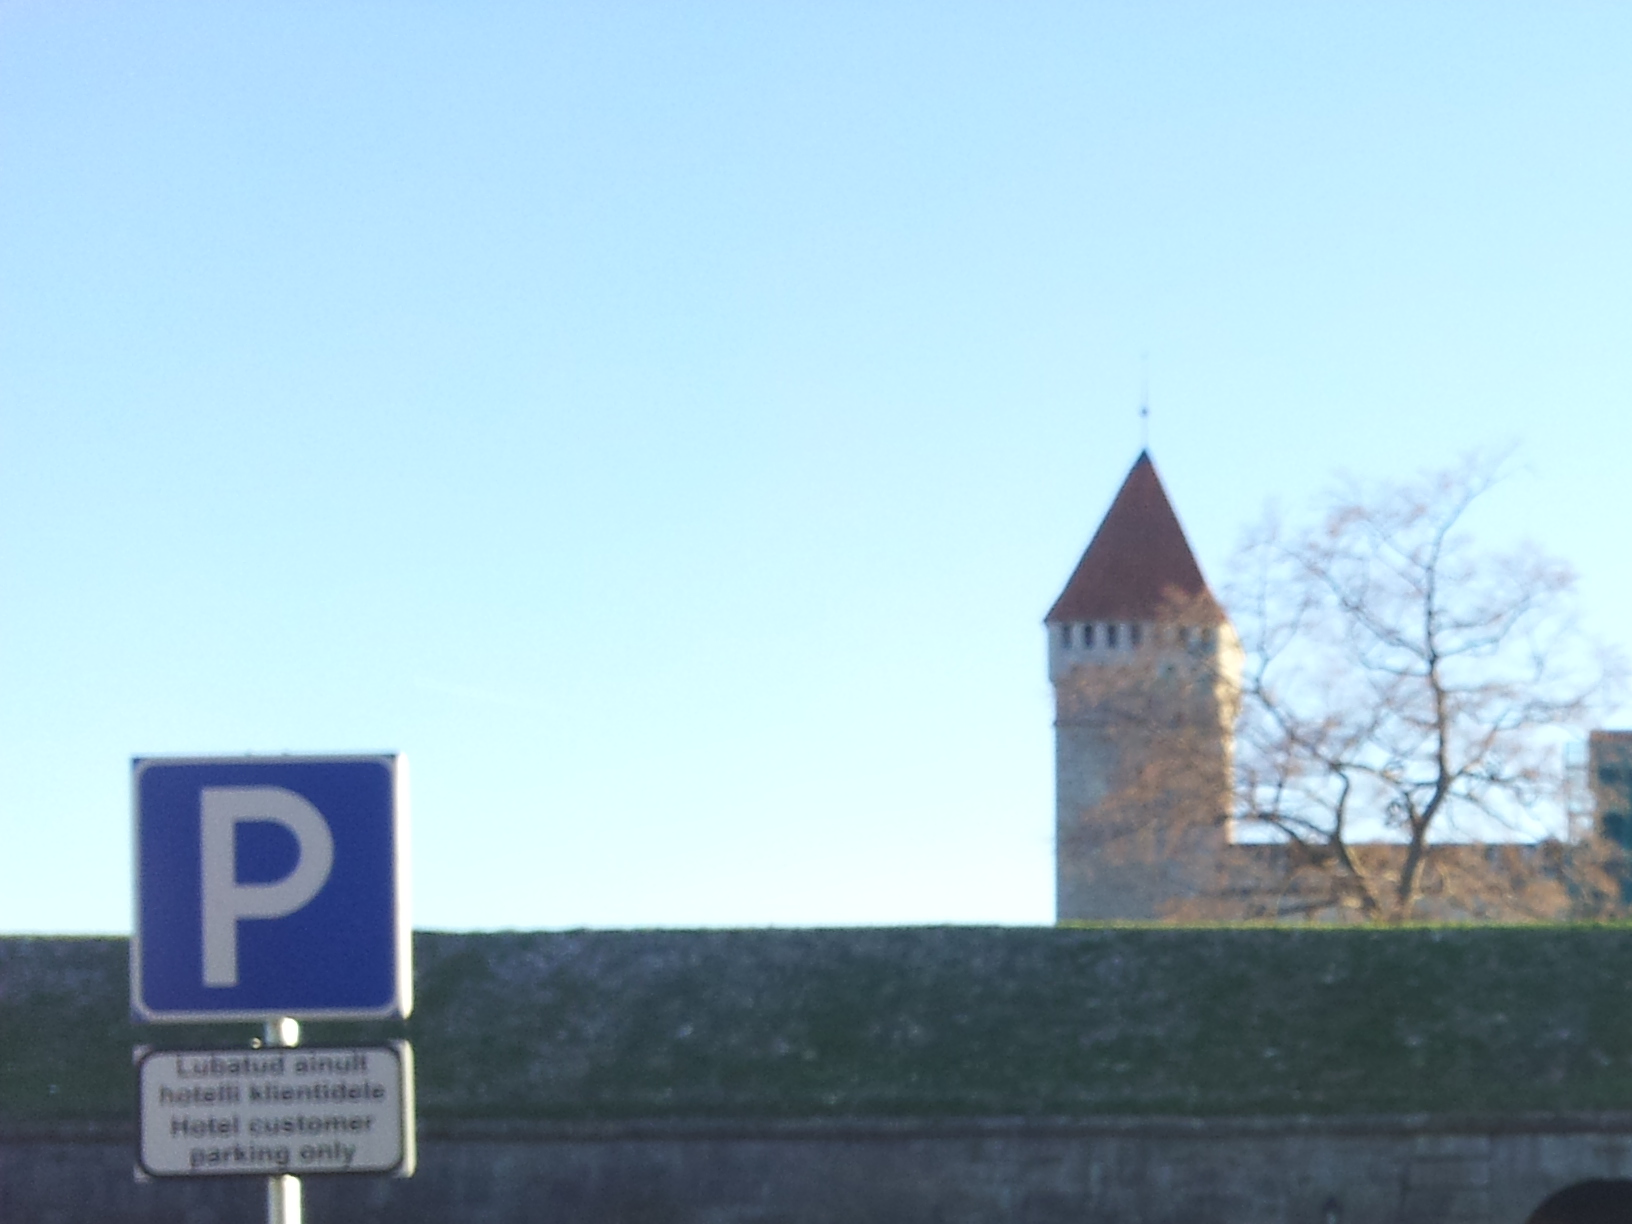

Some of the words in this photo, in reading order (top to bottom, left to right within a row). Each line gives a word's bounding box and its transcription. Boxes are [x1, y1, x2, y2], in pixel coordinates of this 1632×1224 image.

[201, 786, 334, 988] P
[176, 1052, 285, 1077] Lubatud
[294, 1051, 367, 1075] ainult
[159, 1084, 240, 1106] hotelli
[170, 1115, 239, 1137] Hotel
[249, 1113, 374, 1135] customer
[189, 1143, 290, 1167] parking
[300, 1142, 356, 1166] only
